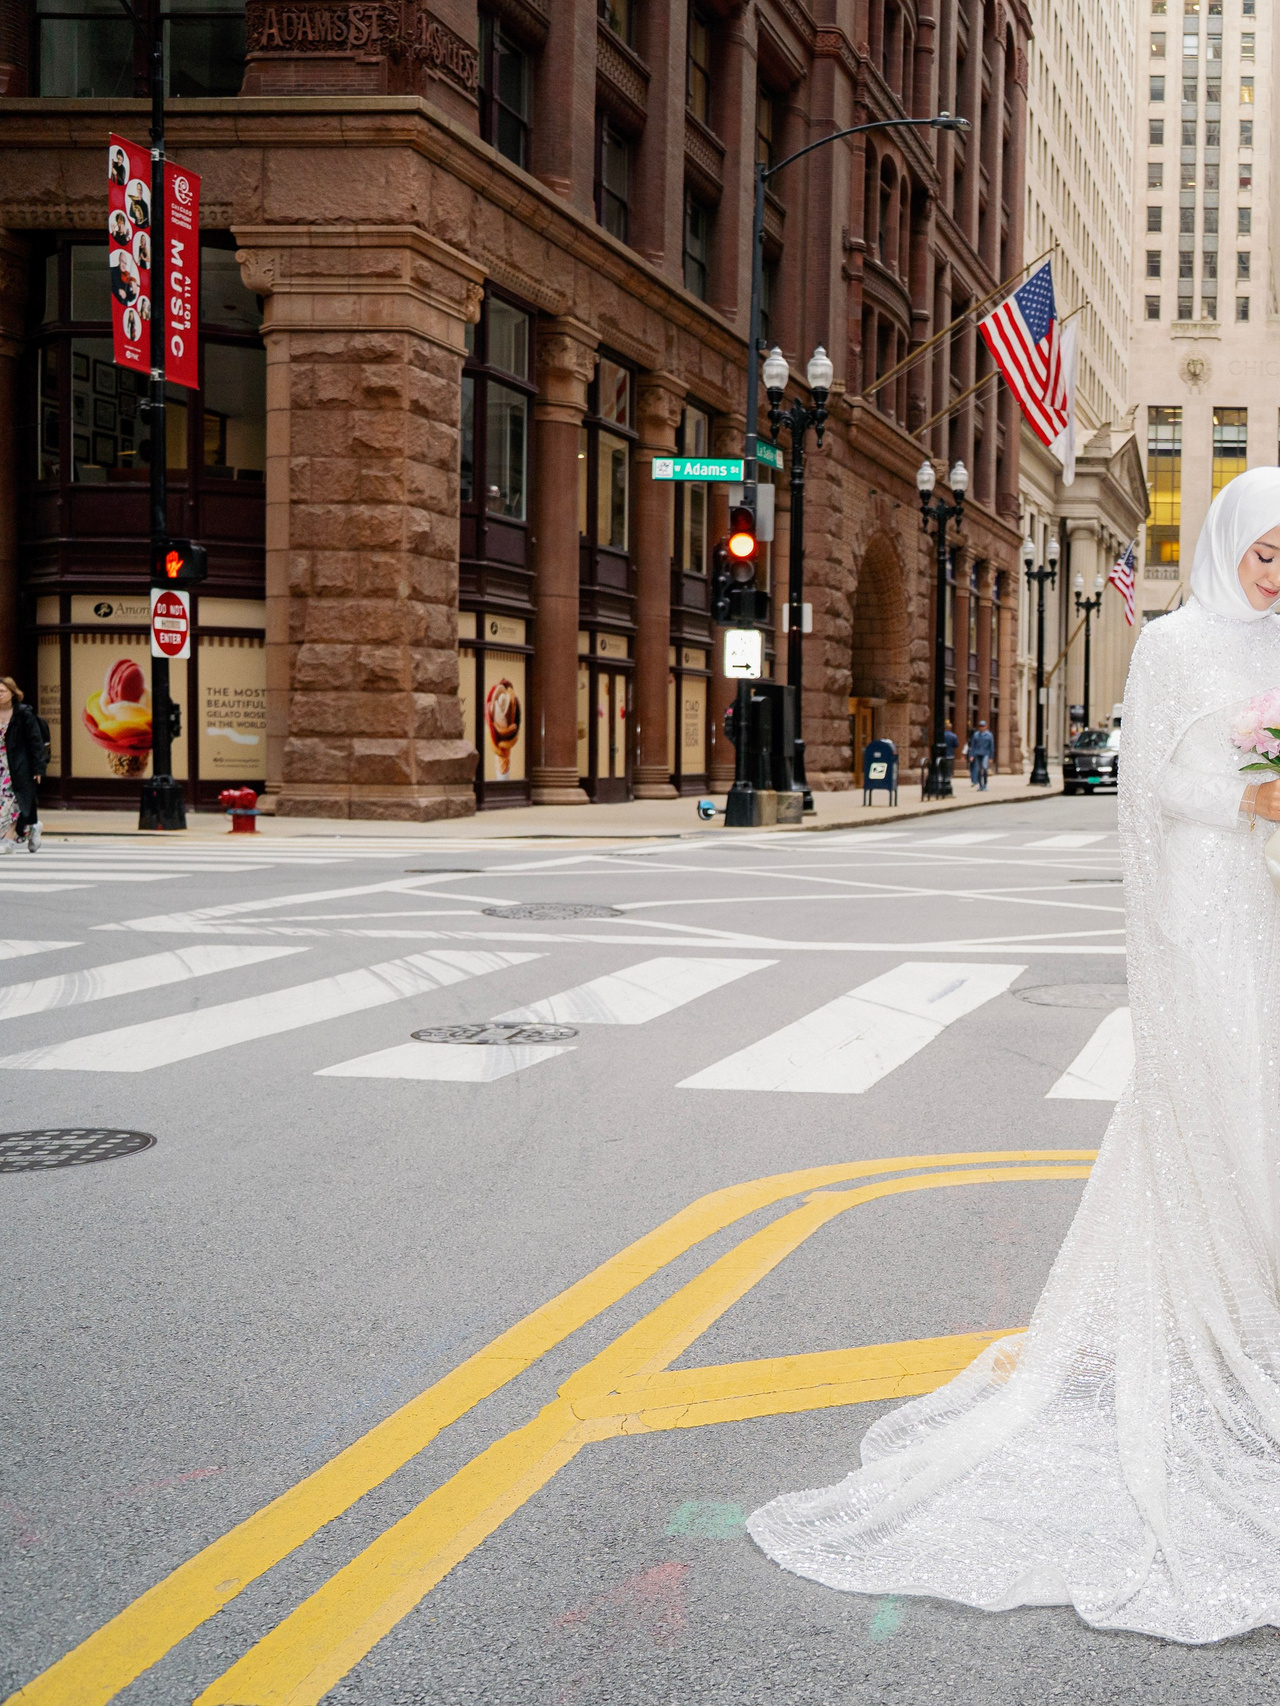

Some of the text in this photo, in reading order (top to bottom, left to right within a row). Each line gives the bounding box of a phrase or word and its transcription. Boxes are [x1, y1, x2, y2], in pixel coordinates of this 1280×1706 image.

[260, 6, 383, 46] ADAMS ST
[170, 239, 185, 357] MUSIC
[183, 303, 191, 329] FOR
[683, 462, 728, 477] Adams
[157, 603, 184, 616] DO NOT
[159, 632, 182, 645] ENTER
[207, 687, 266, 698] THE MOST
[207, 699, 266, 709] BEAUTIFUL
[207, 710, 266, 719] GELATO ROSE
[237, 721, 266, 729] WORLD
